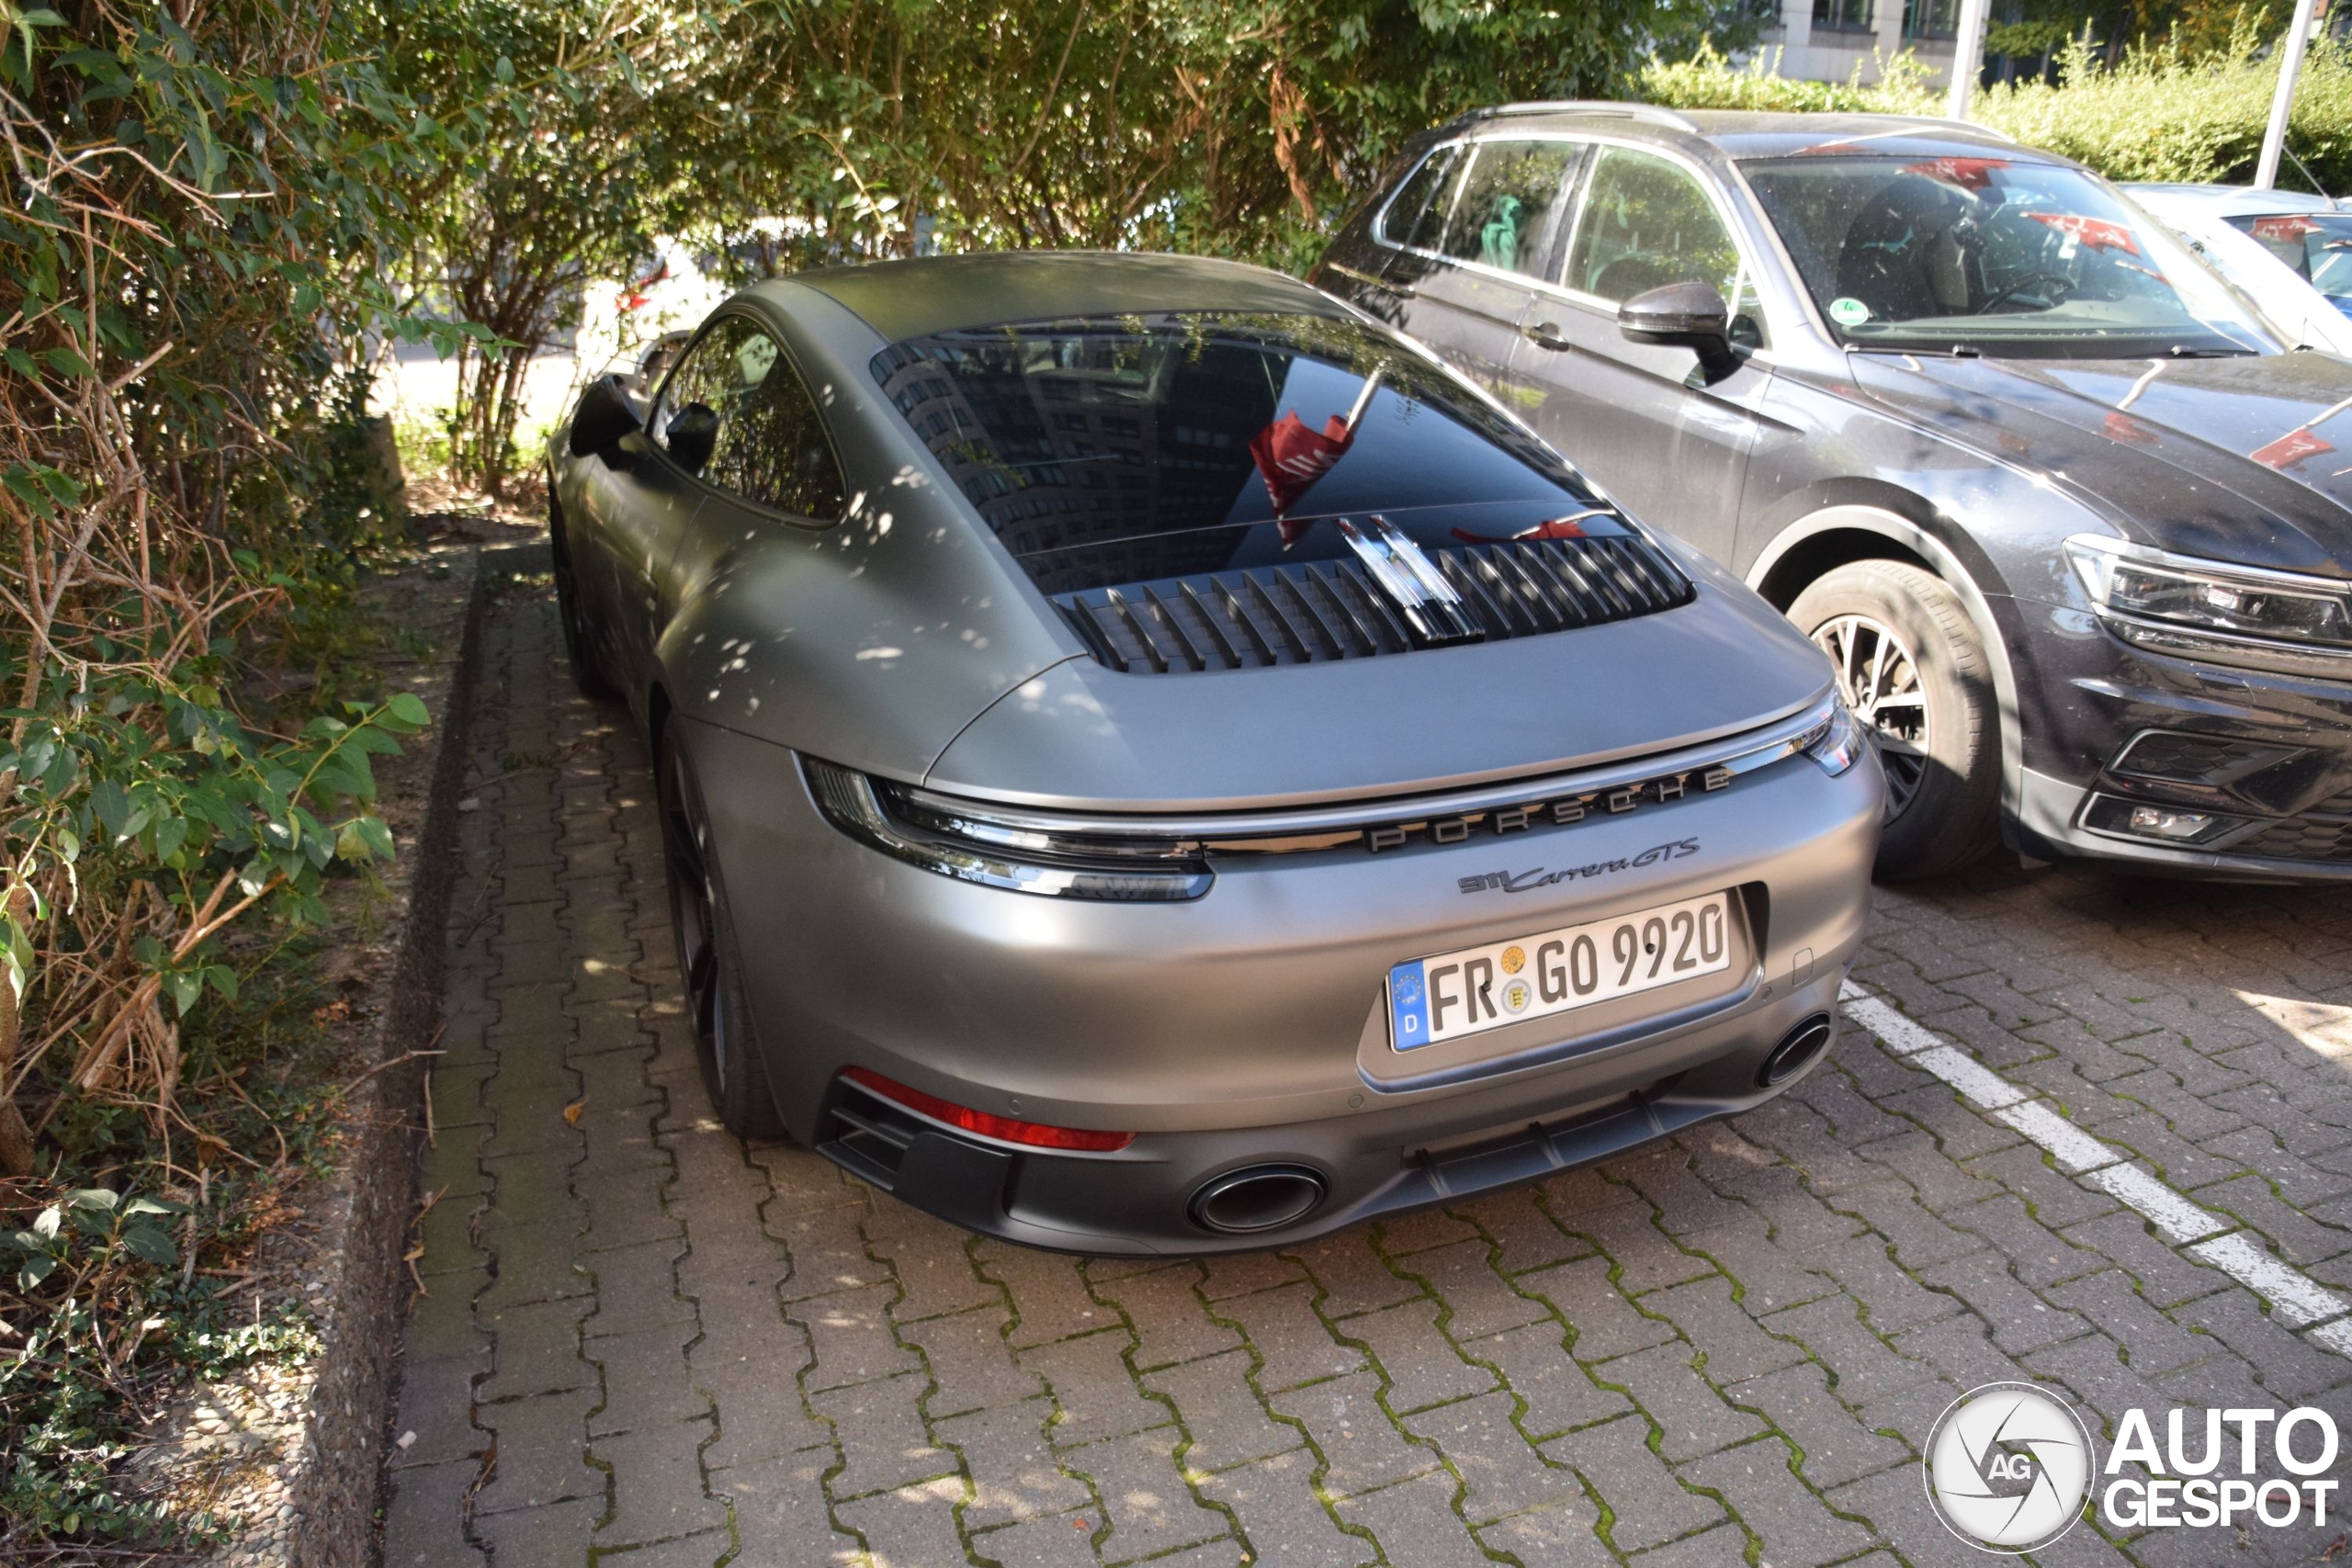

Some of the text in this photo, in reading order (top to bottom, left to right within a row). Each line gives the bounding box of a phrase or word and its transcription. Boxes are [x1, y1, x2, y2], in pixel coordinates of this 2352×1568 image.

[1368, 766, 1730, 852] PORSCHE
[1458, 837, 1701, 894] 911 Carrera GTS
[1429, 957, 1498, 1032] FR
[1536, 934, 1599, 1003] GO
[1612, 904, 1724, 987] 9920
[1404, 1014, 1418, 1033] D
